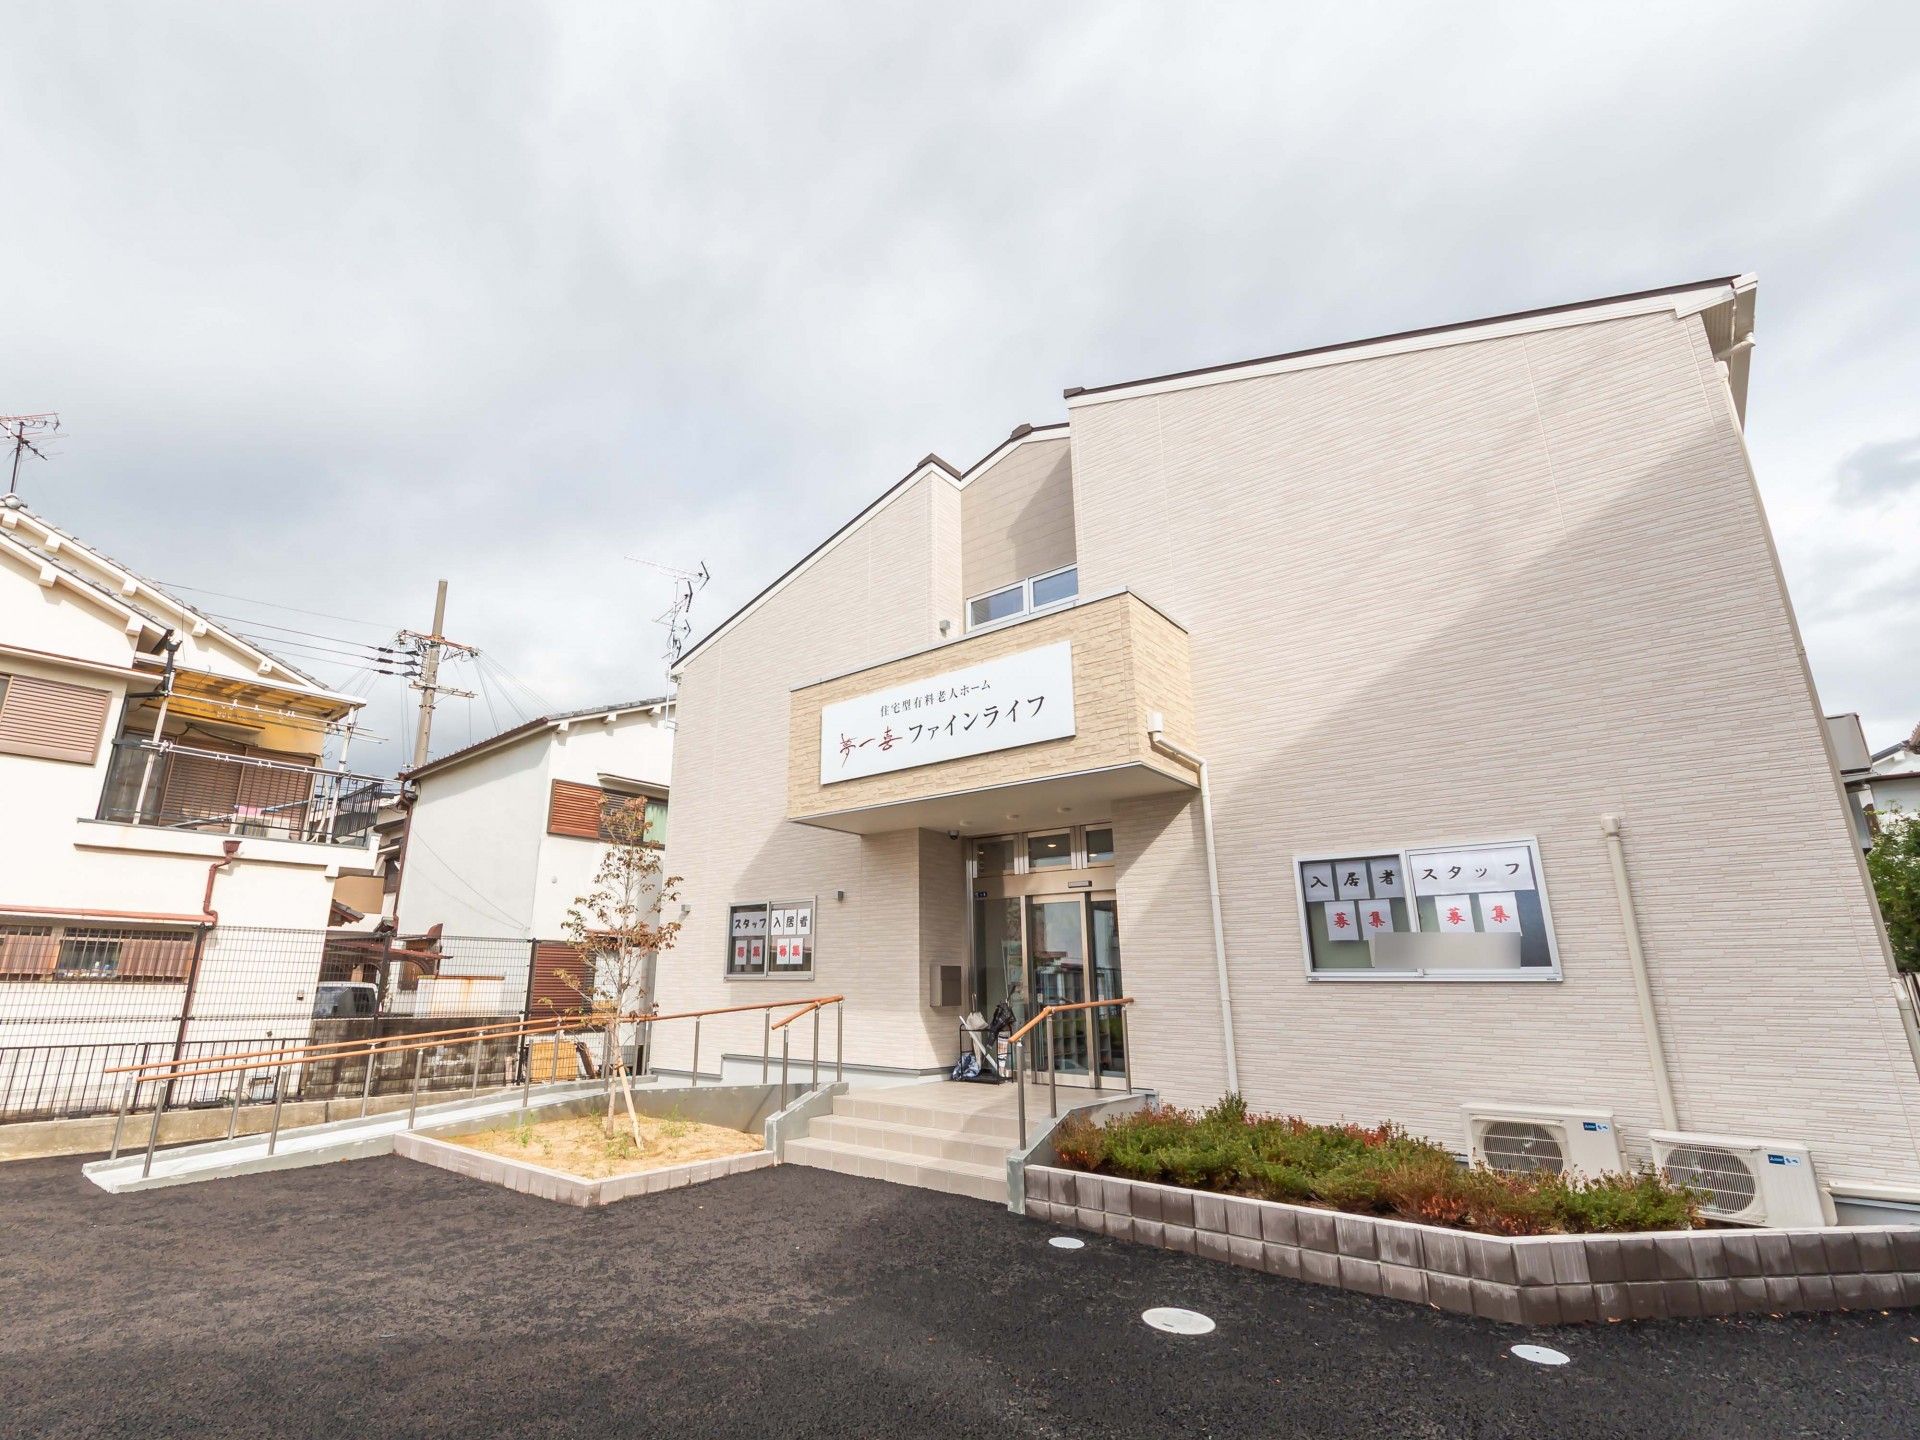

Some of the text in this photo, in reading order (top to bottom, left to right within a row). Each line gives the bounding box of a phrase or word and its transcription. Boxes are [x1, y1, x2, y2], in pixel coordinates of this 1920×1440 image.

[880, 680, 991, 717] 住宅型有料老人ホーム
[909, 695, 1045, 744] ファインライフ
[1310, 868, 1396, 889] 入居者
[1422, 862, 1520, 880] スタッフ
[735, 918, 767, 929] スタッフ
[773, 915, 808, 928] 入居者
[1333, 911, 1386, 929] 募集
[1446, 904, 1511, 925] 募集
